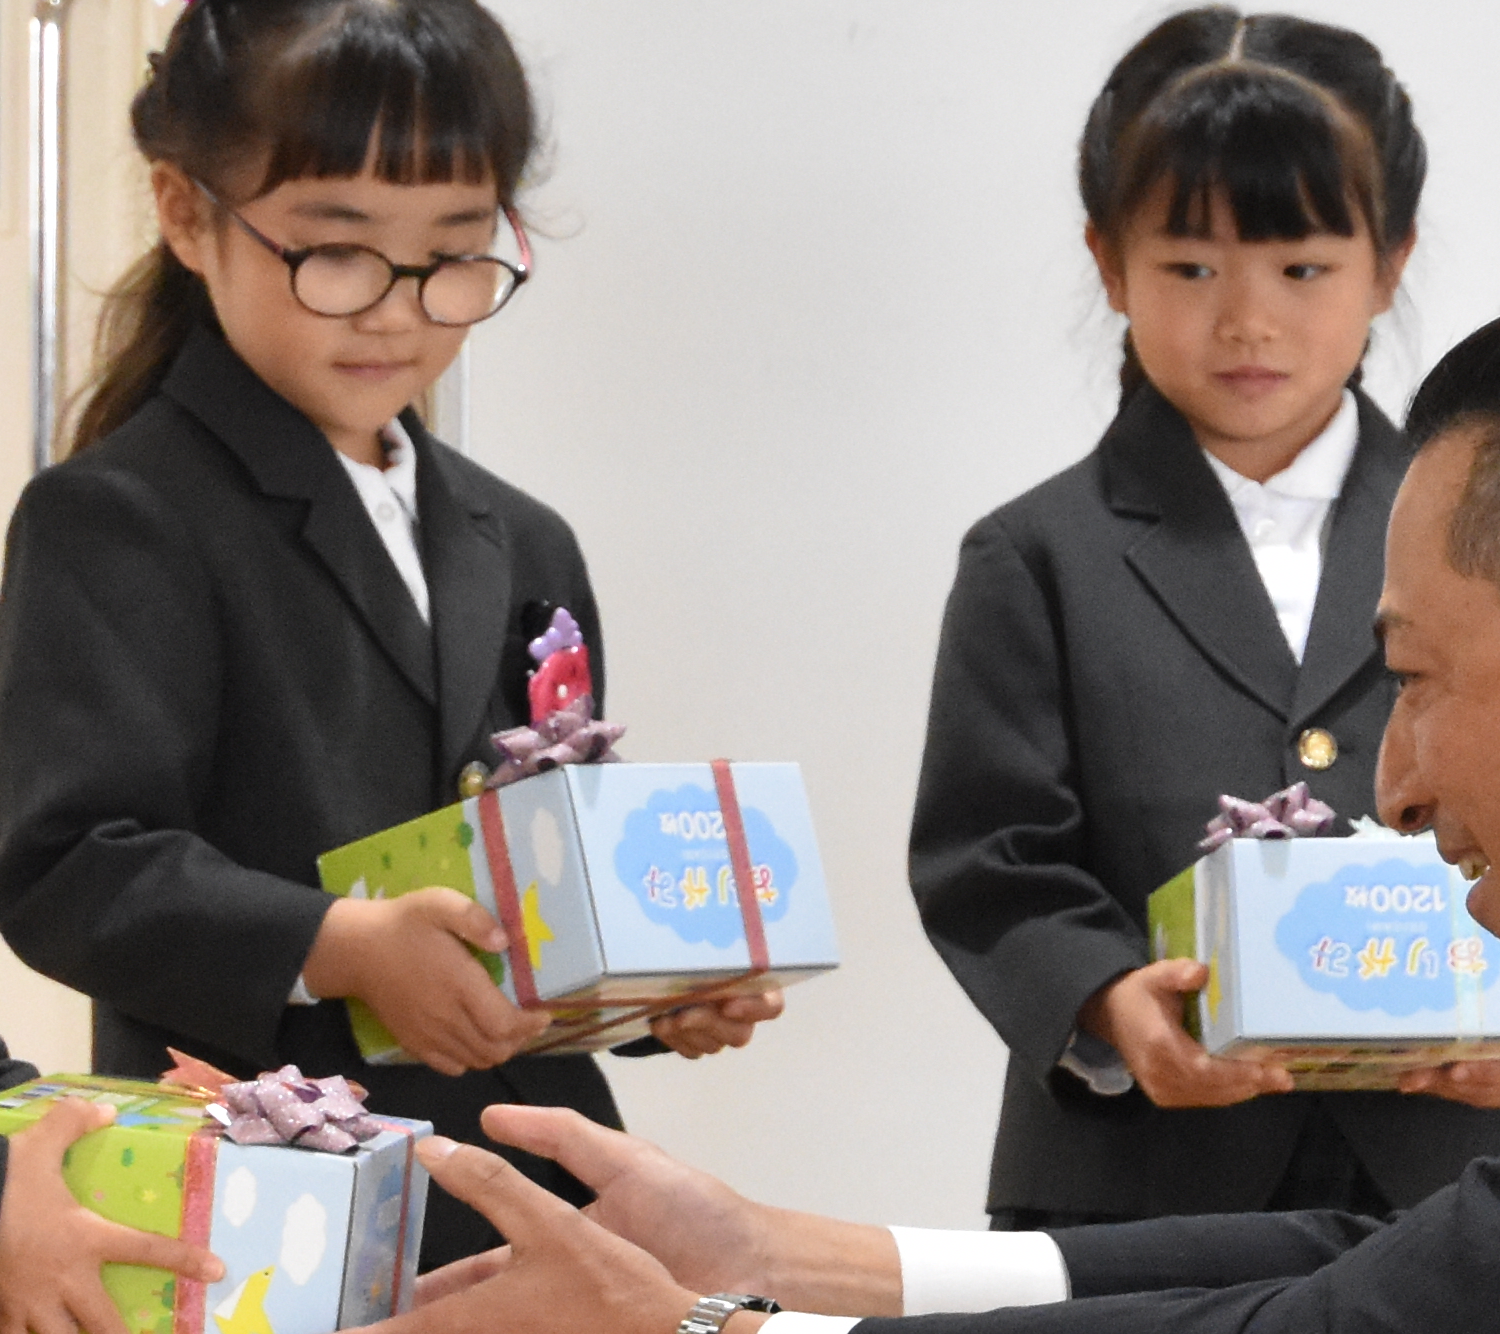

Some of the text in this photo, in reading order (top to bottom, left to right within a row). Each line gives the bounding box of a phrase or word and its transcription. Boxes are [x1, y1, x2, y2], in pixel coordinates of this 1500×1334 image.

[1345, 885, 1446, 913] 1200枚
[1309, 936, 1488, 979] おりがみ
